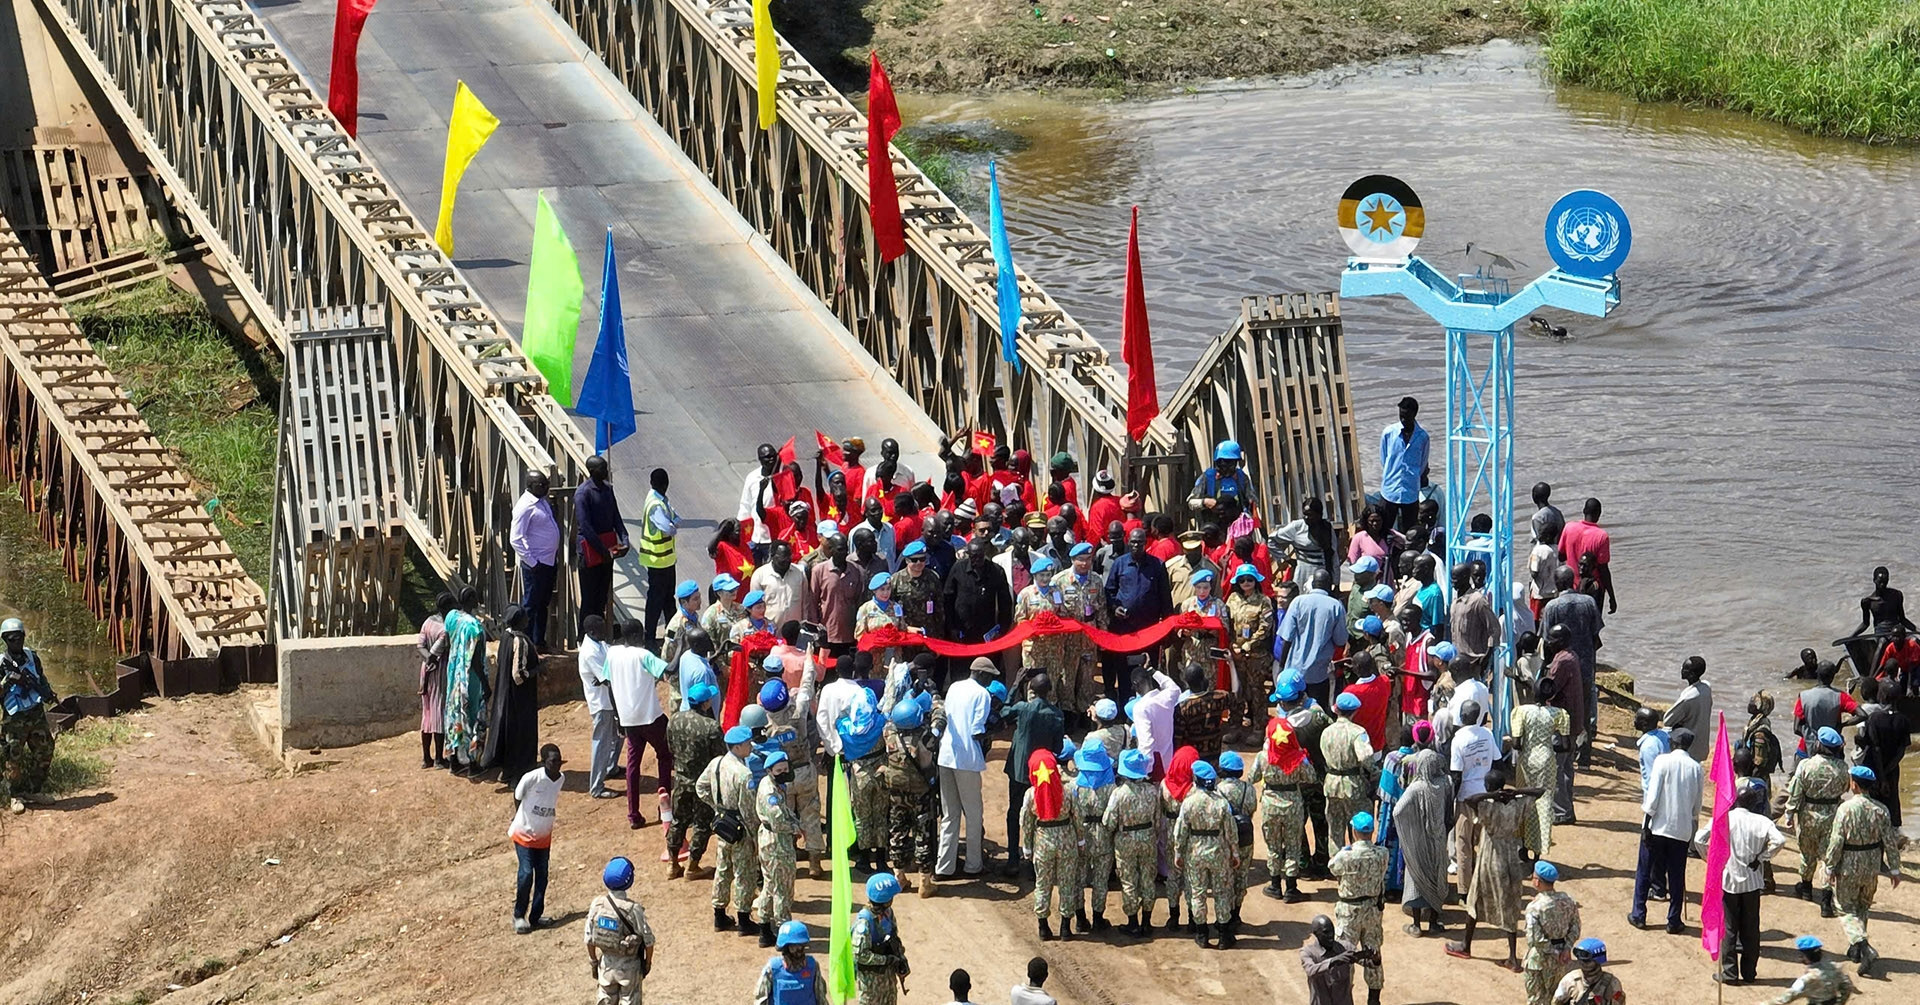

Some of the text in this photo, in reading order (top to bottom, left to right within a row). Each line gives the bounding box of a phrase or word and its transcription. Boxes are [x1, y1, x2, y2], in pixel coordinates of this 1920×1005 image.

[778, 732, 793, 742] UN
[875, 879, 892, 891] UN
[600, 919, 614, 928] UN
